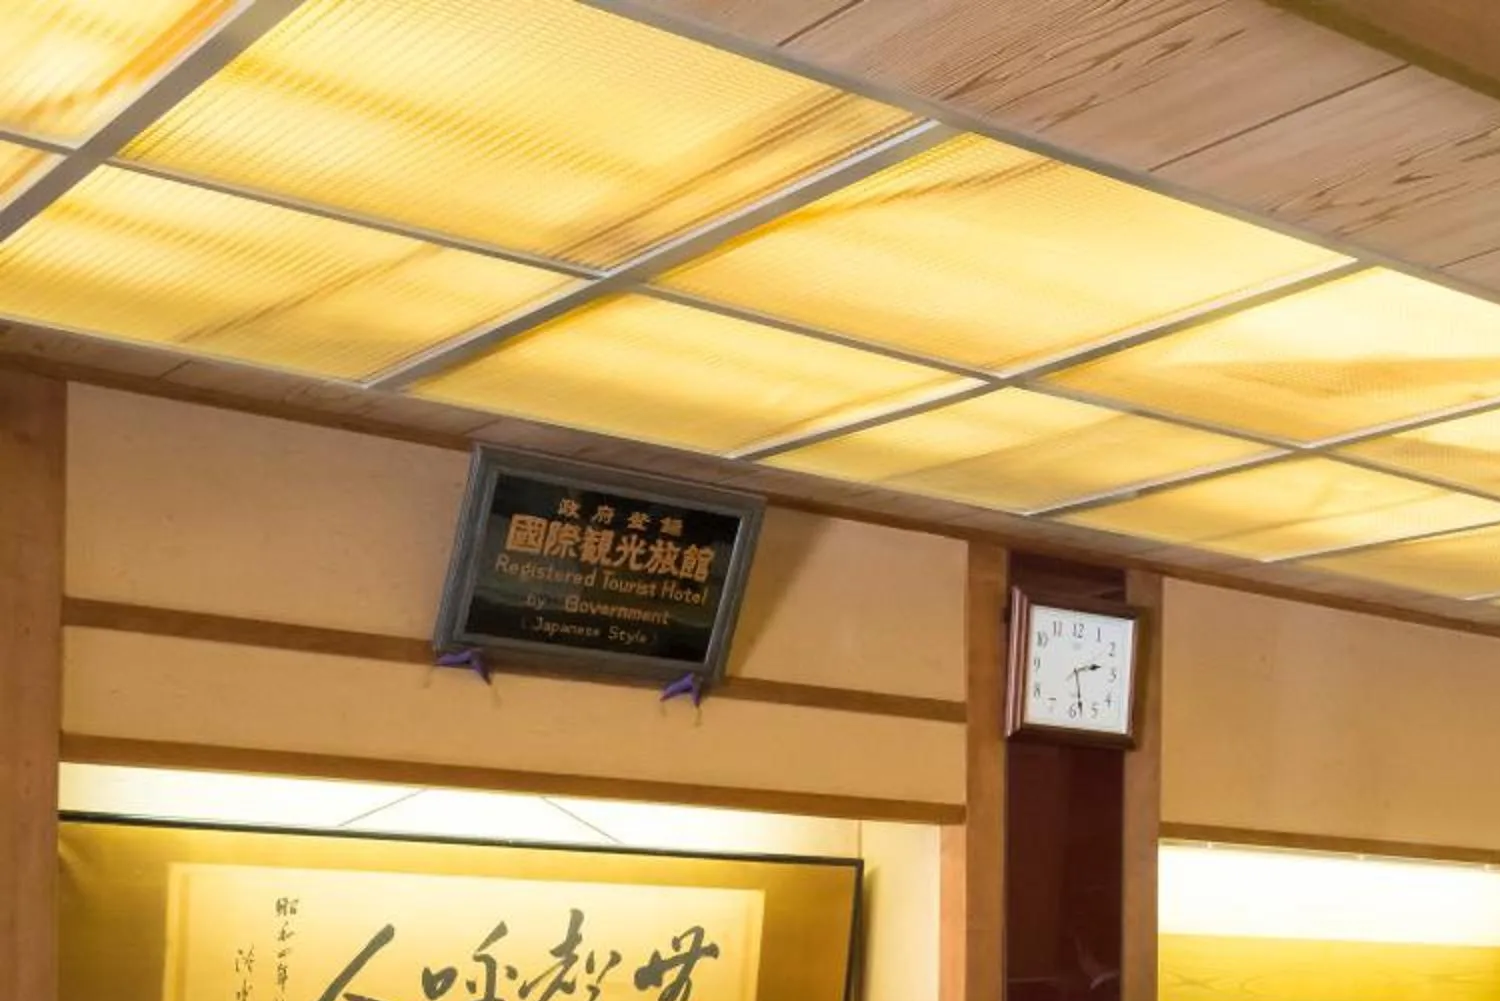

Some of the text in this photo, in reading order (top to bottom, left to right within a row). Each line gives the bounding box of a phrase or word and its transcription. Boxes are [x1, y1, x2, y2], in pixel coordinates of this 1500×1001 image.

[494, 553, 709, 606] Registered Tourist Hotel
[524, 592, 671, 626] by Government
